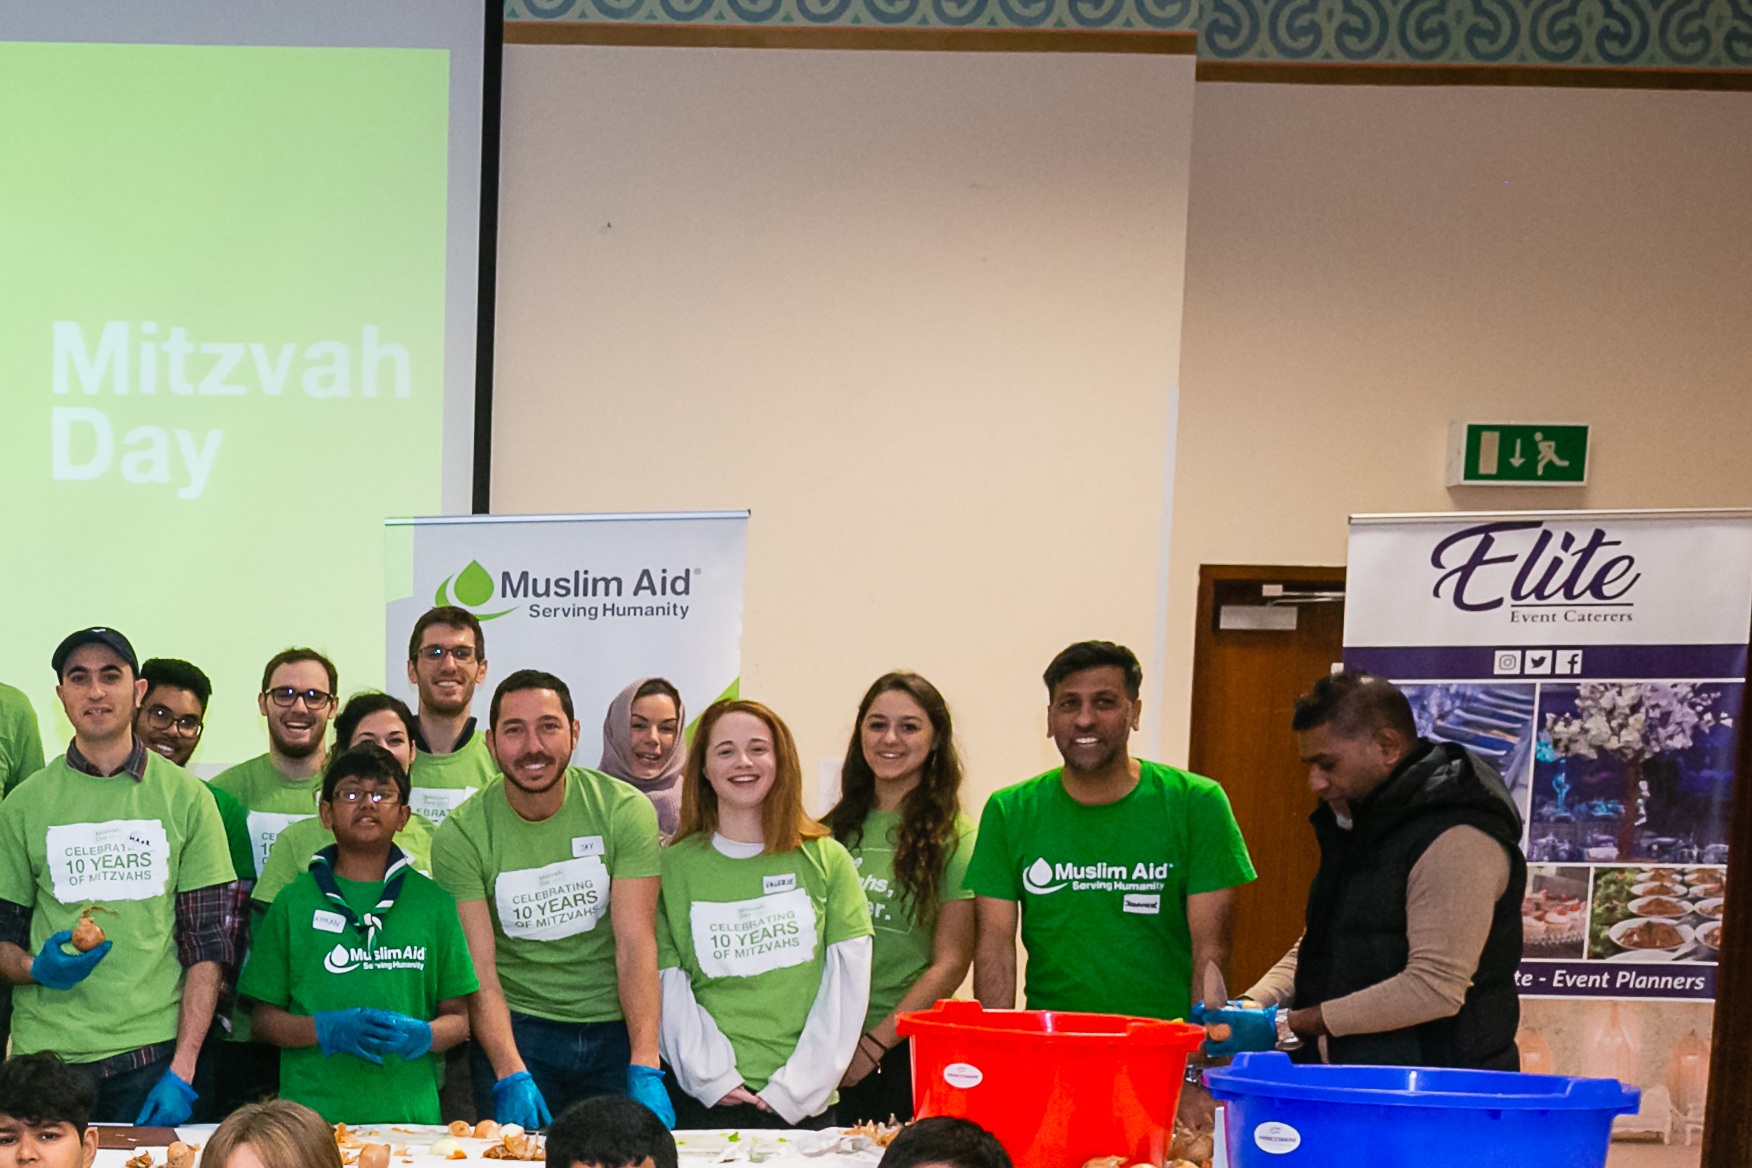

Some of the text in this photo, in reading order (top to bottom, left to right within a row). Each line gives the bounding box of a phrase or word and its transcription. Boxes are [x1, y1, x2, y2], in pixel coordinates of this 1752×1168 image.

[52, 320, 412, 399] Mitzvah
[52, 406, 224, 499] Day
[1431, 520, 1641, 612] Elite
[501, 569, 623, 598] Muslim
[529, 602, 689, 620] Serving Humanity
[1510, 610, 1633, 623] Event Caterers
[66, 852, 152, 874] 10 YEARS
[1055, 862, 1168, 881] Muslim Aid
[68, 870, 152, 886] OF MITZVAHS
[1072, 881, 1165, 891] Serving Humanity
[512, 879, 594, 905] CELEBRATING
[513, 890, 598, 920] 10 YEARS
[515, 904, 599, 928] OF MITZVAHS
[709, 910, 796, 932] CELEBRATING
[710, 920, 799, 949] 10 YEARS
[403, 945, 425, 960] Aid
[713, 937, 800, 960] OF MITZVAHS
[392, 961, 425, 971] Humanity
[1552, 969, 1610, 988] Event
[1615, 970, 1706, 990] Planners
